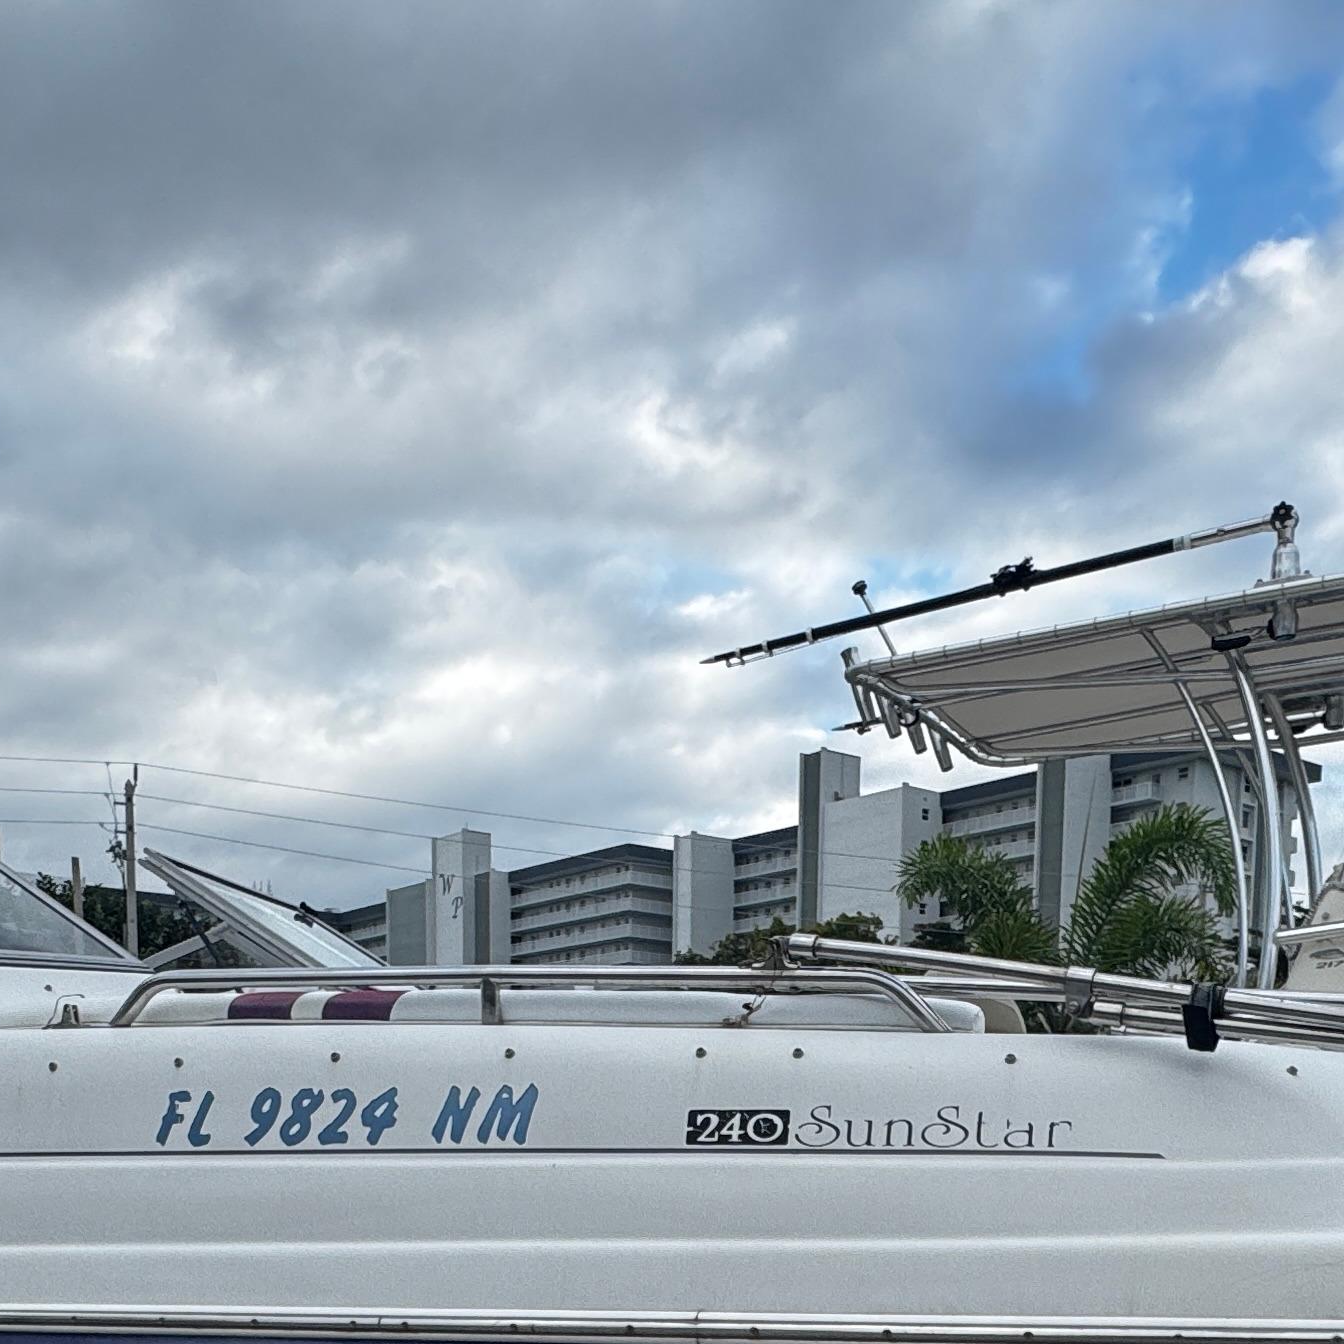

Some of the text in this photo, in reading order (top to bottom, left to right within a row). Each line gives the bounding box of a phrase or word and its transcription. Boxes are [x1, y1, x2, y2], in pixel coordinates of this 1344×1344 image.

[156, 1082, 539, 1147] FL 9824 NM
[691, 1105, 1073, 1149] 240 SunStar
